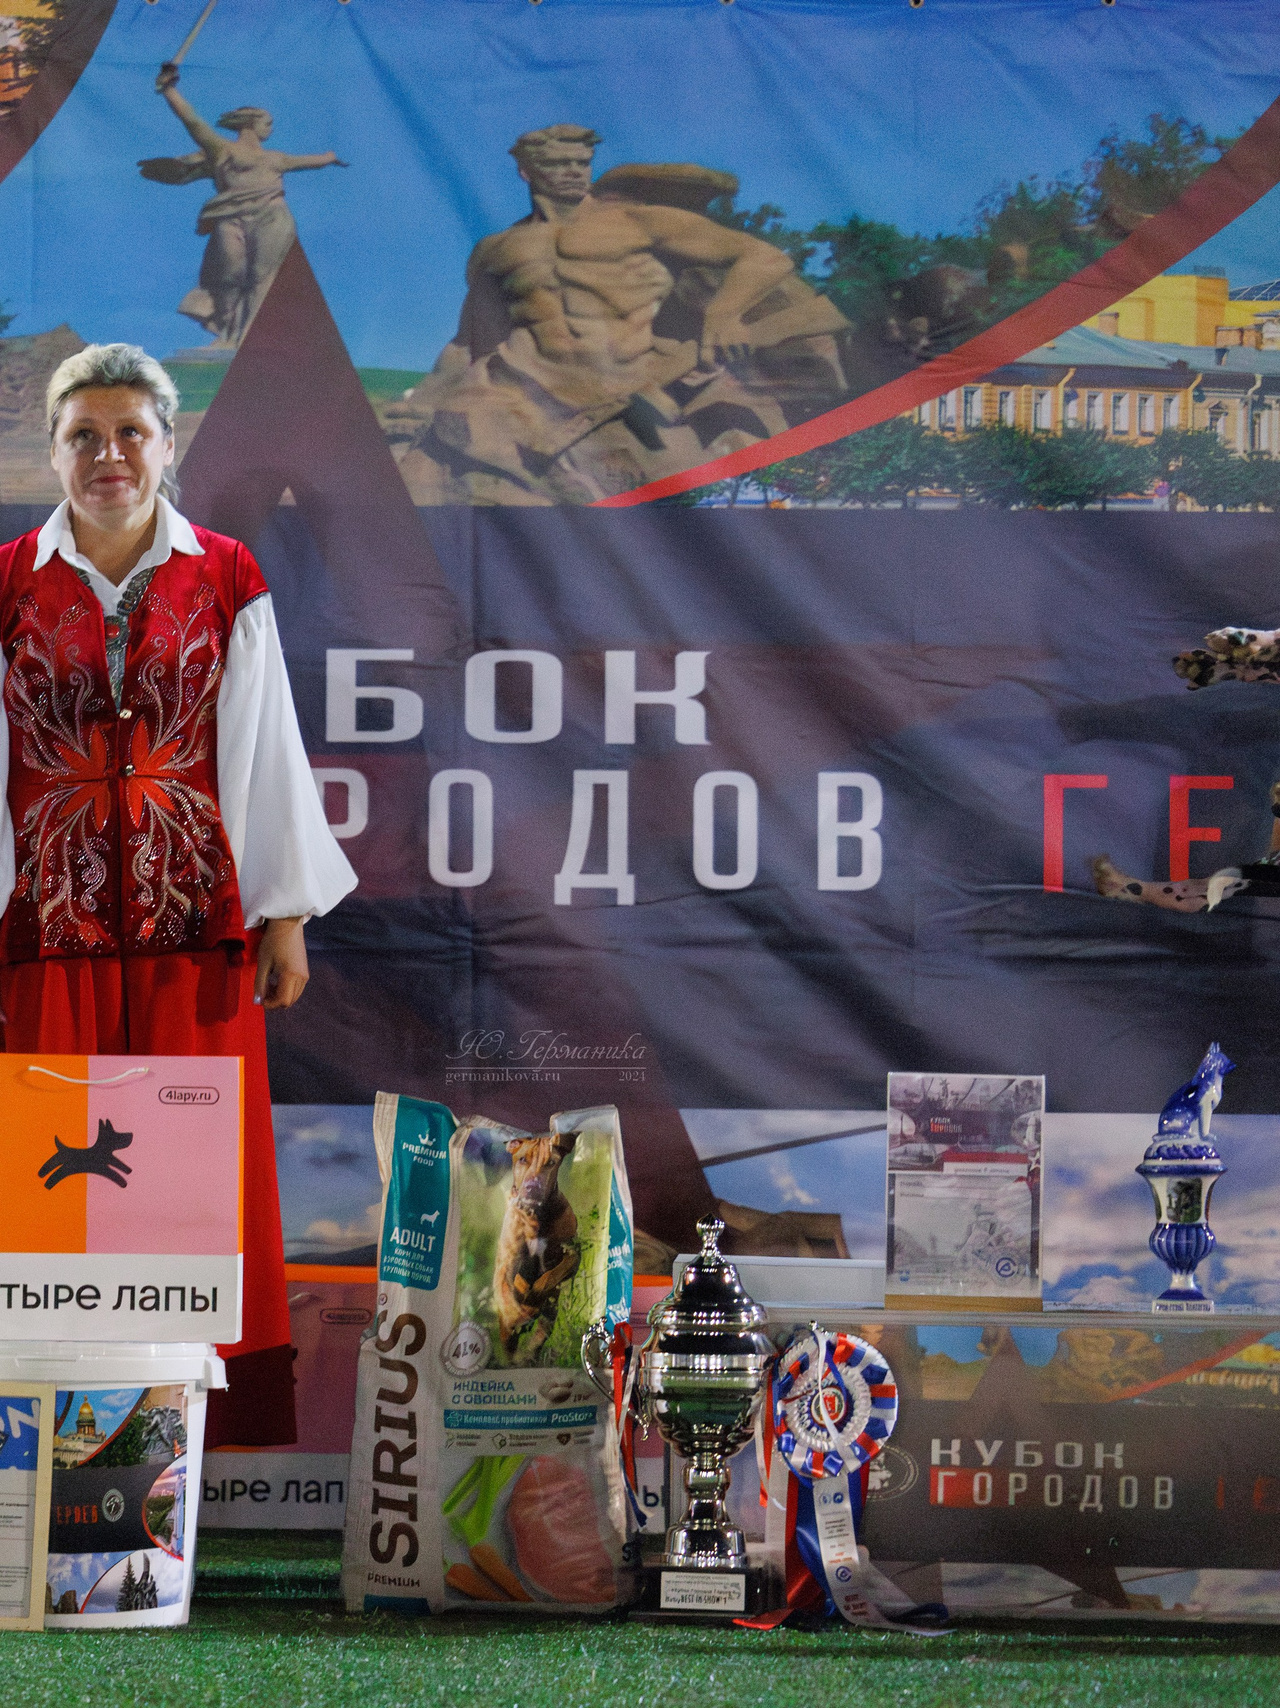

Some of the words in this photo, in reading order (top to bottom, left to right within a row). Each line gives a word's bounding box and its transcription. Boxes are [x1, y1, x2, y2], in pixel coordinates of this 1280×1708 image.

[166, 1090, 211, 1102] 4lapy.ru
[402, 1141, 447, 1160] PREMIUM
[413, 1155, 434, 1167] FOOD
[389, 1226, 436, 1252] ADULT
[112, 1284, 218, 1312] лапы
[453, 1380, 515, 1392] ИНДЕЙКА
[465, 1394, 538, 1406] ОВОЩАМИ
[369, 1310, 426, 1568] SIRIUS
[931, 1438, 1124, 1469] КУБОК
[937, 1471, 1174, 1513] ГОРОДОВ
[368, 1572, 421, 1588] PREMIUM
